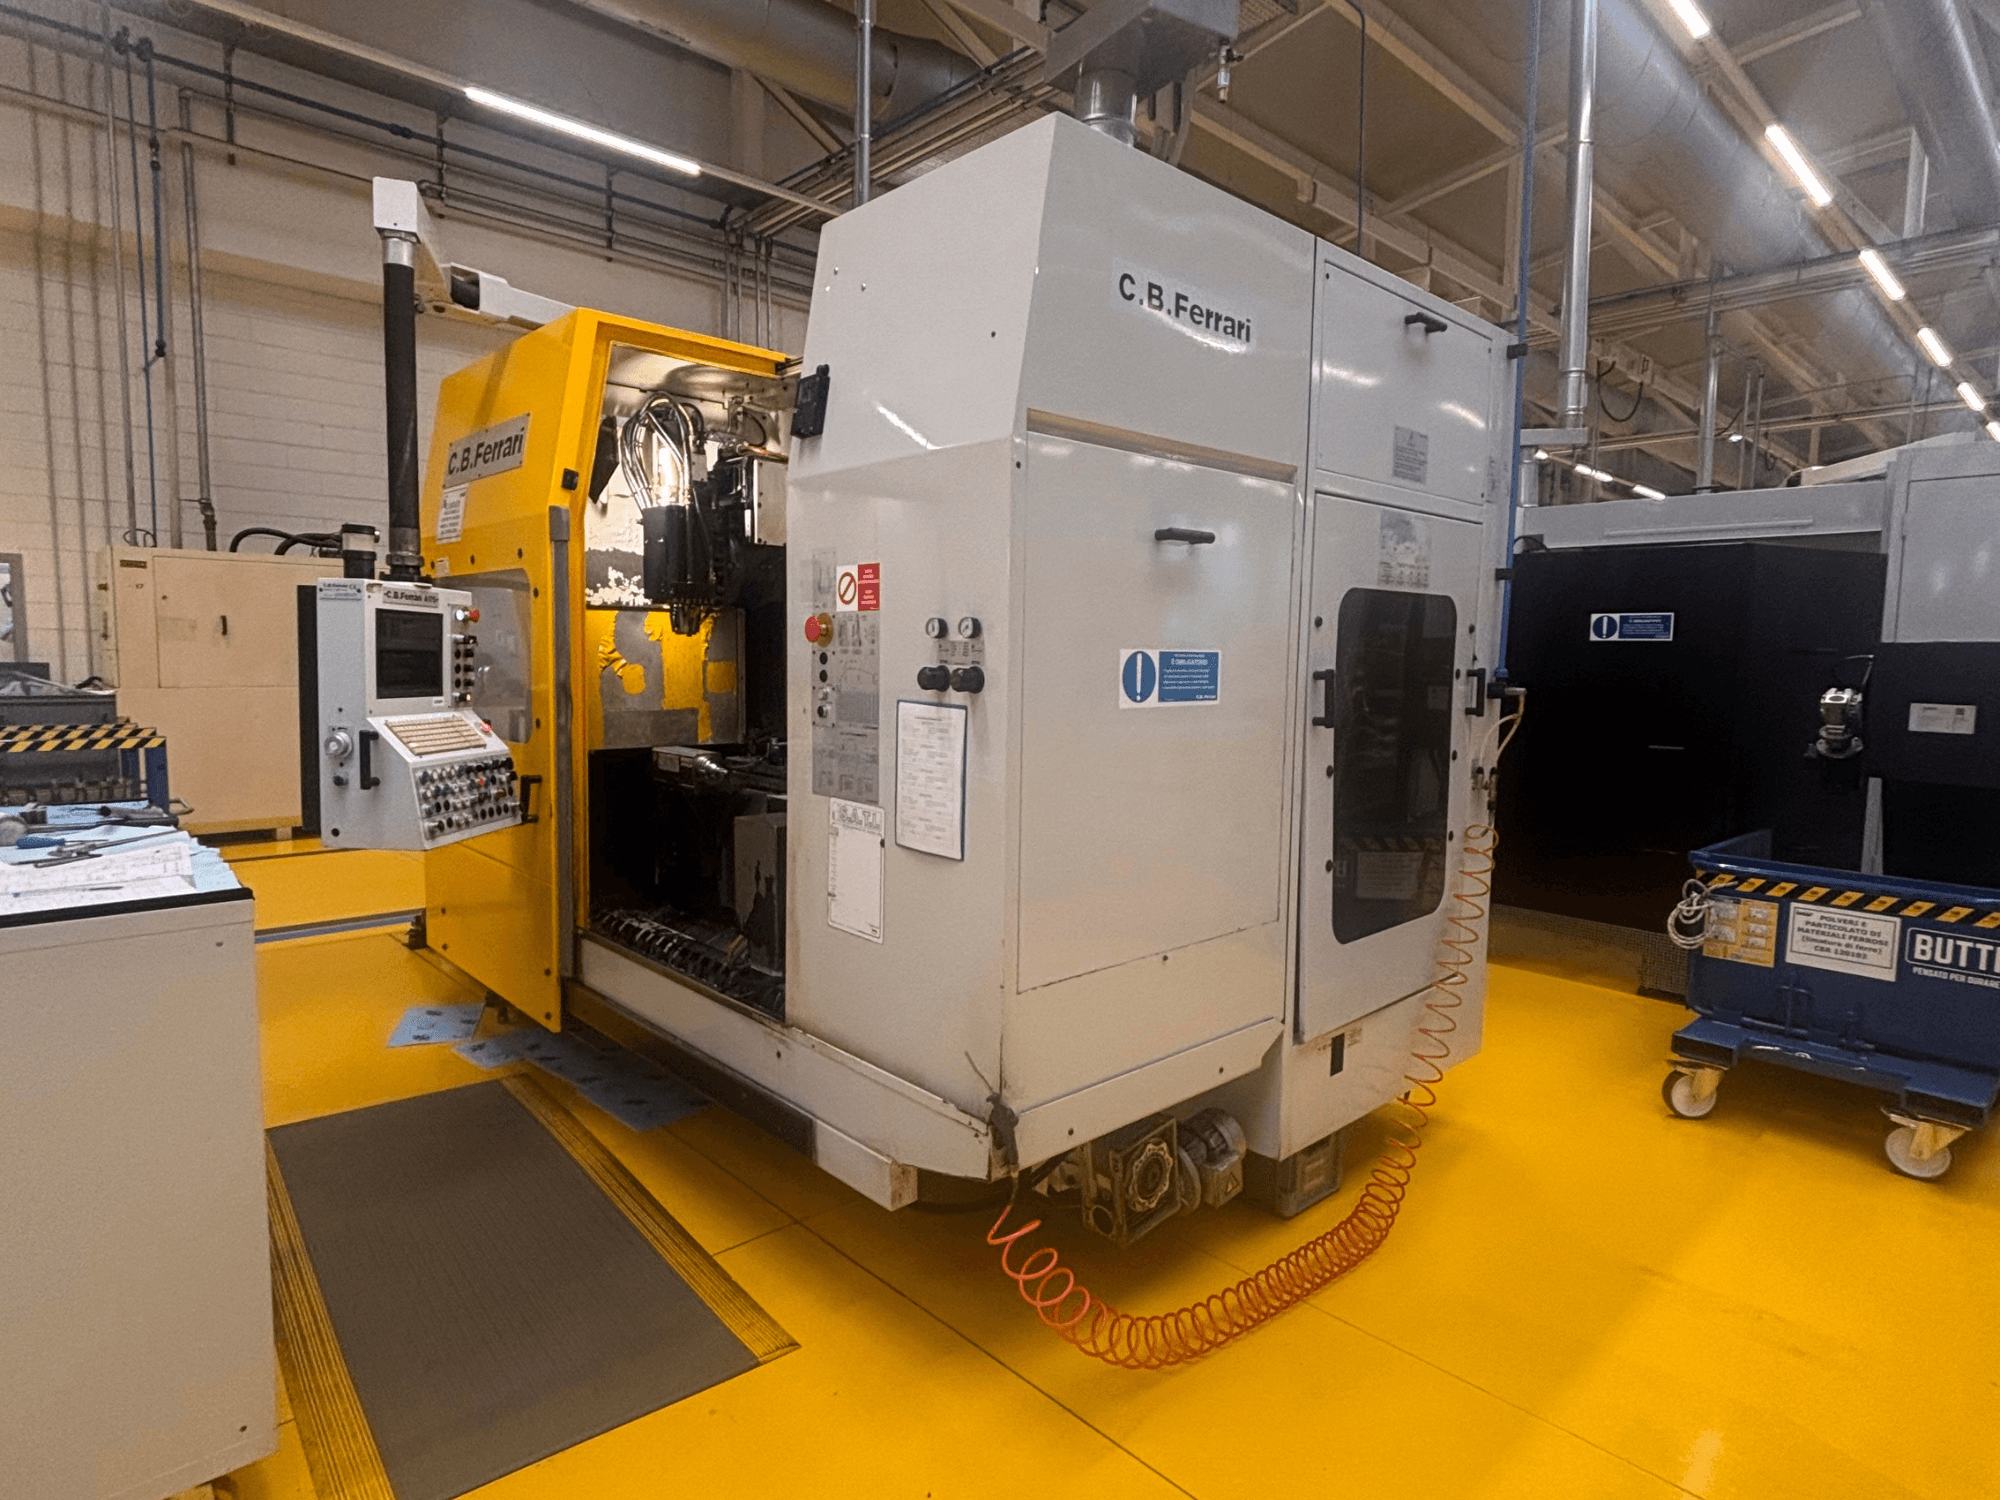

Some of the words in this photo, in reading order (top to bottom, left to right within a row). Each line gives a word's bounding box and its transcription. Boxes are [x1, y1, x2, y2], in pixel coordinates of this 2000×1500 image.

[1119, 273, 1252, 343] C.B.Ferrari
[448, 426, 525, 475] C.B.Ferrari
[1820, 915, 1859, 926] POLVERI
